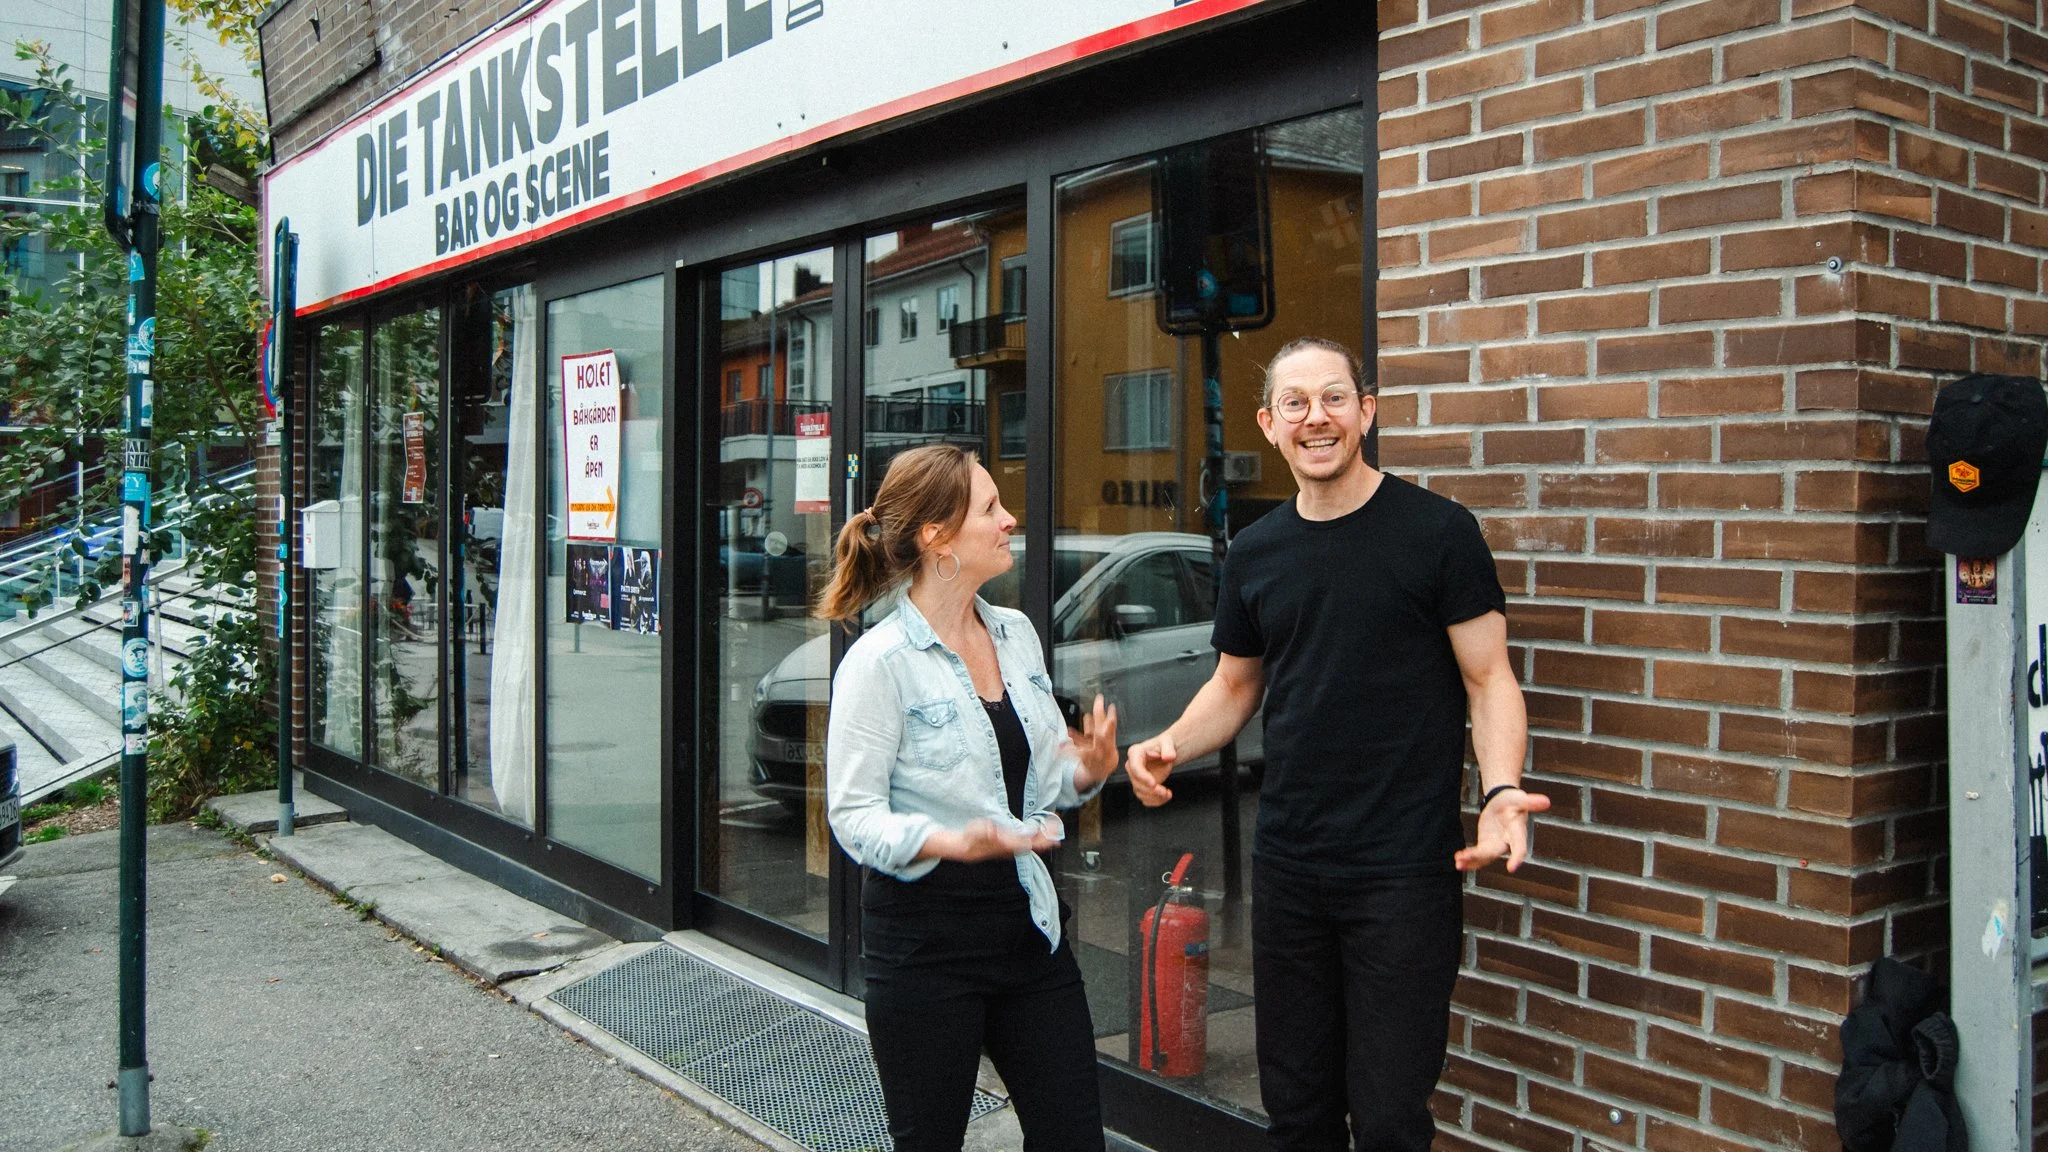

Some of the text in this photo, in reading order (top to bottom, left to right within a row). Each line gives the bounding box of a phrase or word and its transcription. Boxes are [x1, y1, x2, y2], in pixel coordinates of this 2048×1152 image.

[356, 0, 773, 227] DIE TANKSTELLE
[435, 130, 611, 256] BAR OG SCENE
[590, 434, 599, 451] ER
[585, 455, 603, 478] ÅPEN
[0, 800, 17, 826] 9426
